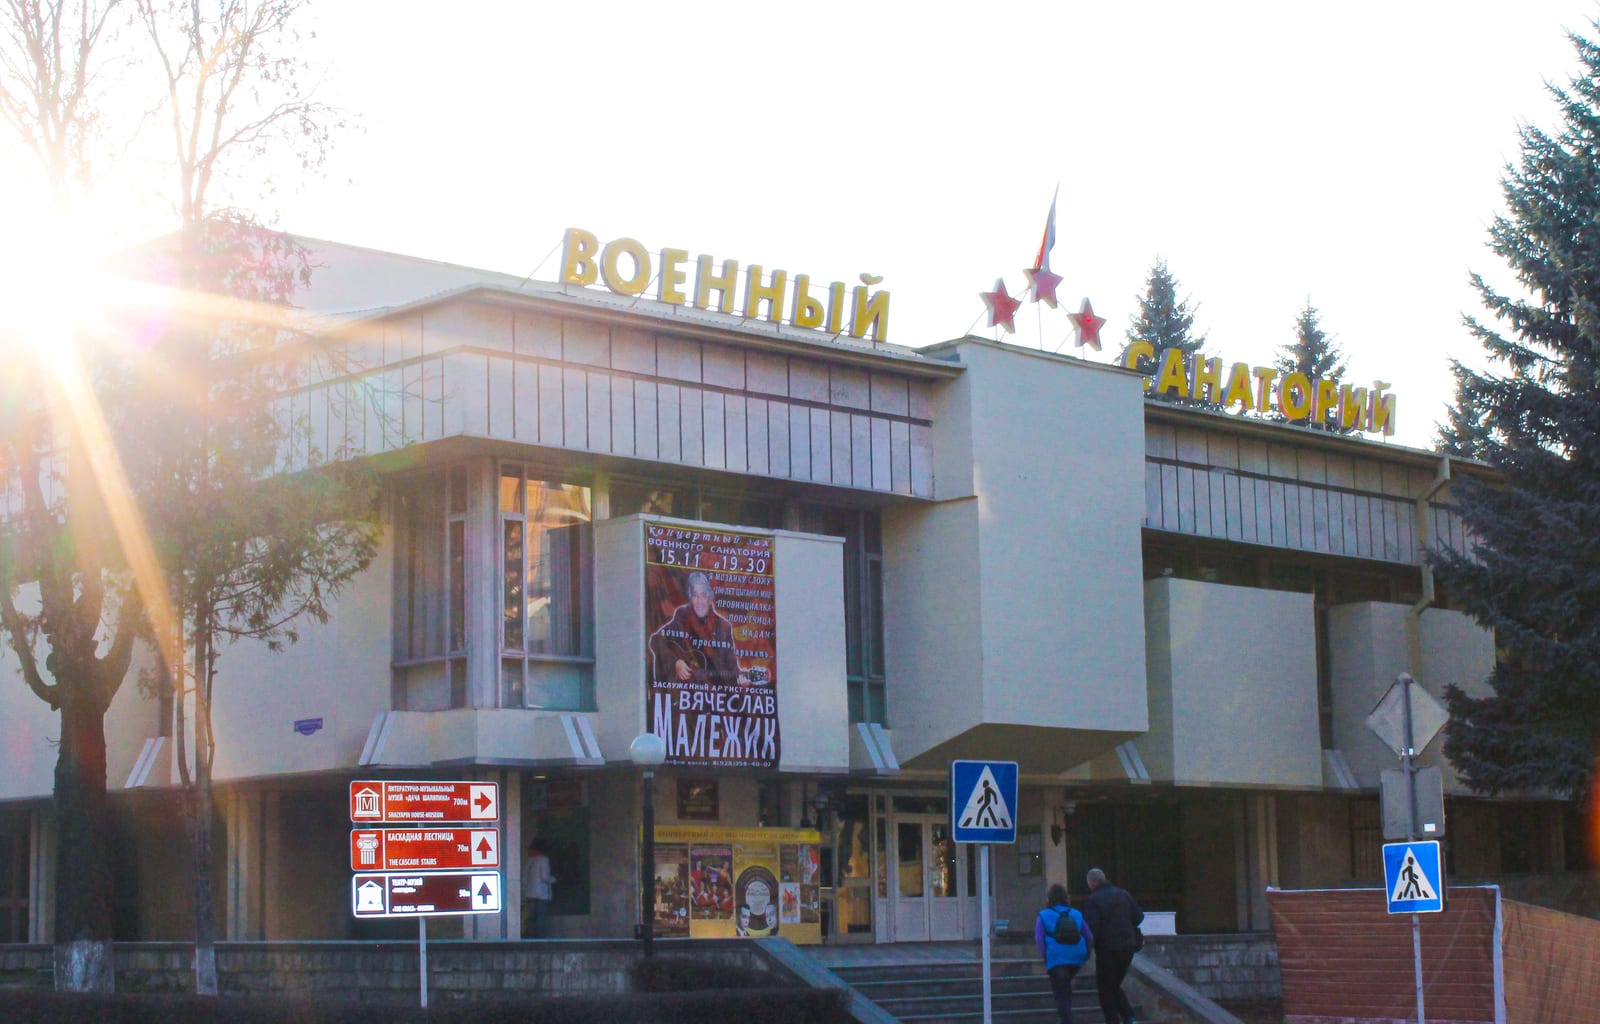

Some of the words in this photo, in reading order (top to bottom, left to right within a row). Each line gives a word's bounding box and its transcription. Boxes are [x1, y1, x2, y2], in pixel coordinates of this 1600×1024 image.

[559, 227, 891, 343] ВОЕННЫЙ
[1121, 340, 1397, 436] САНАТОРИЙ
[648, 538, 704, 552] ВОЕННОГО
[710, 545, 770, 558] САНАТОРИЯ
[660, 548, 700, 568] 15.11
[722, 555, 766, 574] 19.30
[711, 685, 742, 693] АРТИСТ
[745, 687, 774, 695] РОССИИ
[679, 691, 775, 714] ВЯЧЕСЛАВ
[654, 693, 776, 759] МАЛЕЖИК
[387, 832, 422, 842] КАСКАДНАЯ
[424, 832, 454, 842] ЛЕСТНИЦА
